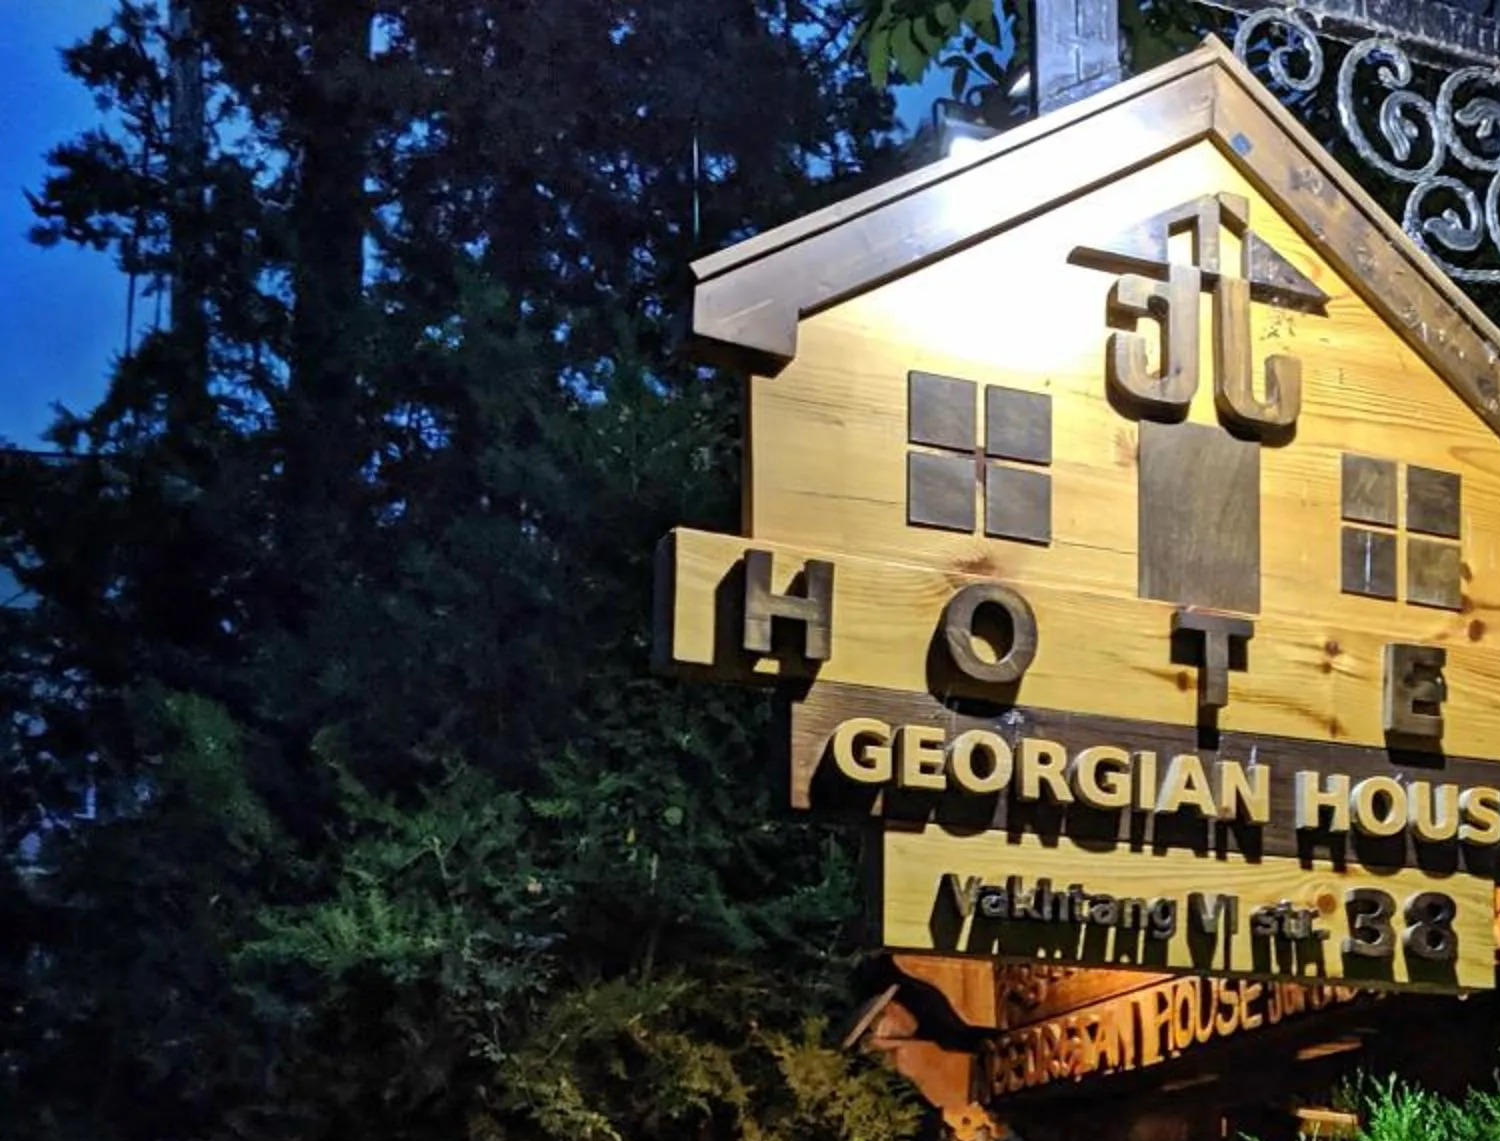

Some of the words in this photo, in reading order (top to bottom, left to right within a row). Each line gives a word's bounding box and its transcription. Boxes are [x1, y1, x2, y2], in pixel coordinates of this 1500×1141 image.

[831, 716, 1273, 826] GEORGIAN
[948, 873, 1178, 938] Vakhtang
[1189, 892, 1239, 935] VI
[1342, 887, 1459, 960] 38
